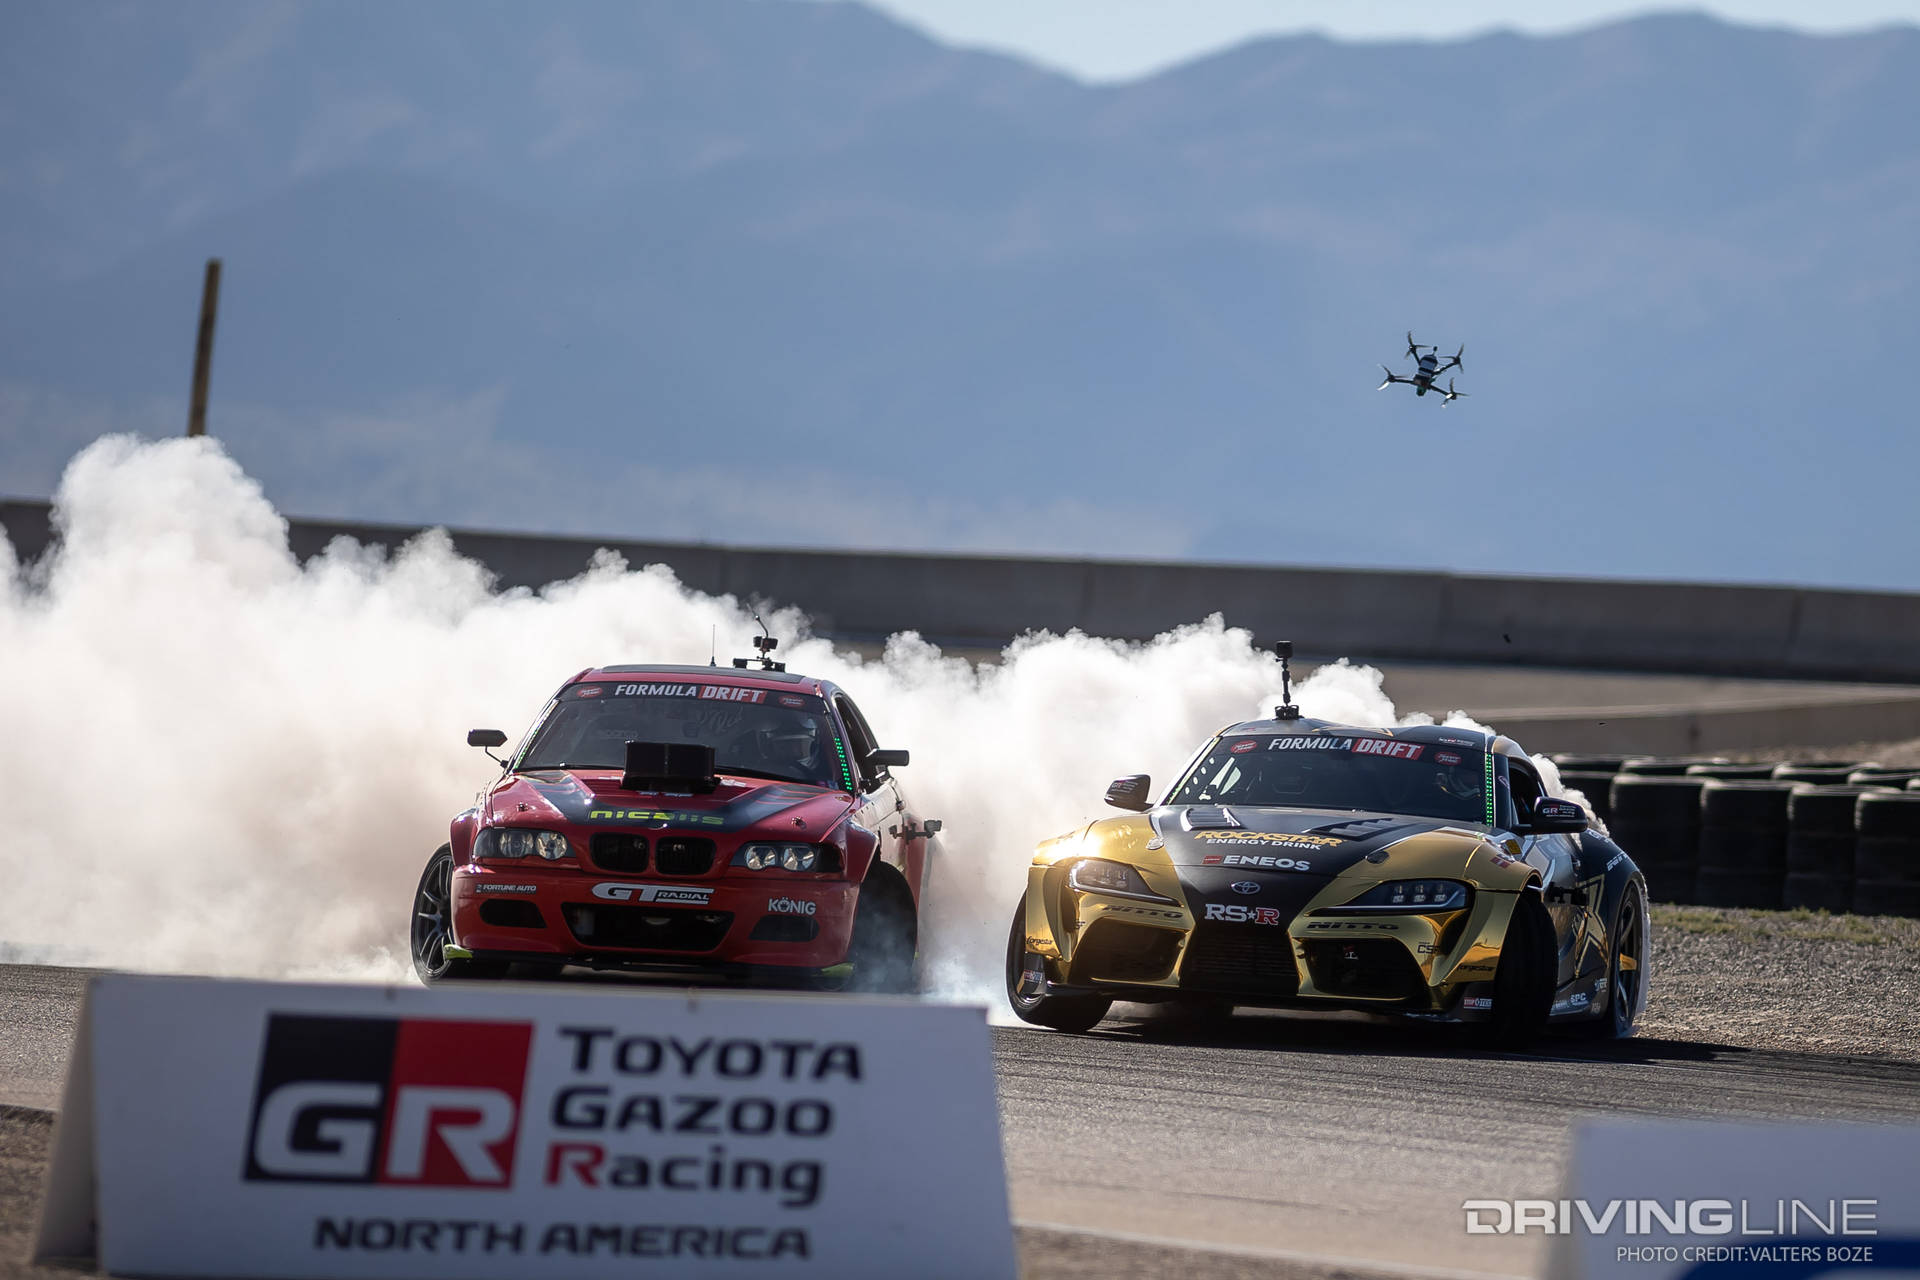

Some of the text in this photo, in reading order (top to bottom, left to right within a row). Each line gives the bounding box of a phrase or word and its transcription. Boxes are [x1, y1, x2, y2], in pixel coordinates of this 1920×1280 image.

[615, 684, 697, 697] FORMULA
[702, 685, 764, 703] DRIFT
[1268, 738, 1353, 750] FORMULA
[1356, 739, 1421, 758] DRIFT
[1194, 831, 1345, 847] ROCKSTAR
[1206, 838, 1321, 851] ENERGY DRINK
[1223, 855, 1312, 871] ENEOS
[657, 890, 710, 901] RADIAL
[768, 897, 817, 915] KÖNIG
[1102, 905, 1184, 918] NITTO
[1307, 921, 1399, 930] NITTO
[559, 1026, 862, 1081] TOYOTA
[553, 1085, 832, 1137] GAZOO
[254, 1081, 517, 1182] GR
[544, 1142, 823, 1208] Racing
[314, 1218, 812, 1259] NORTH AMERICA
